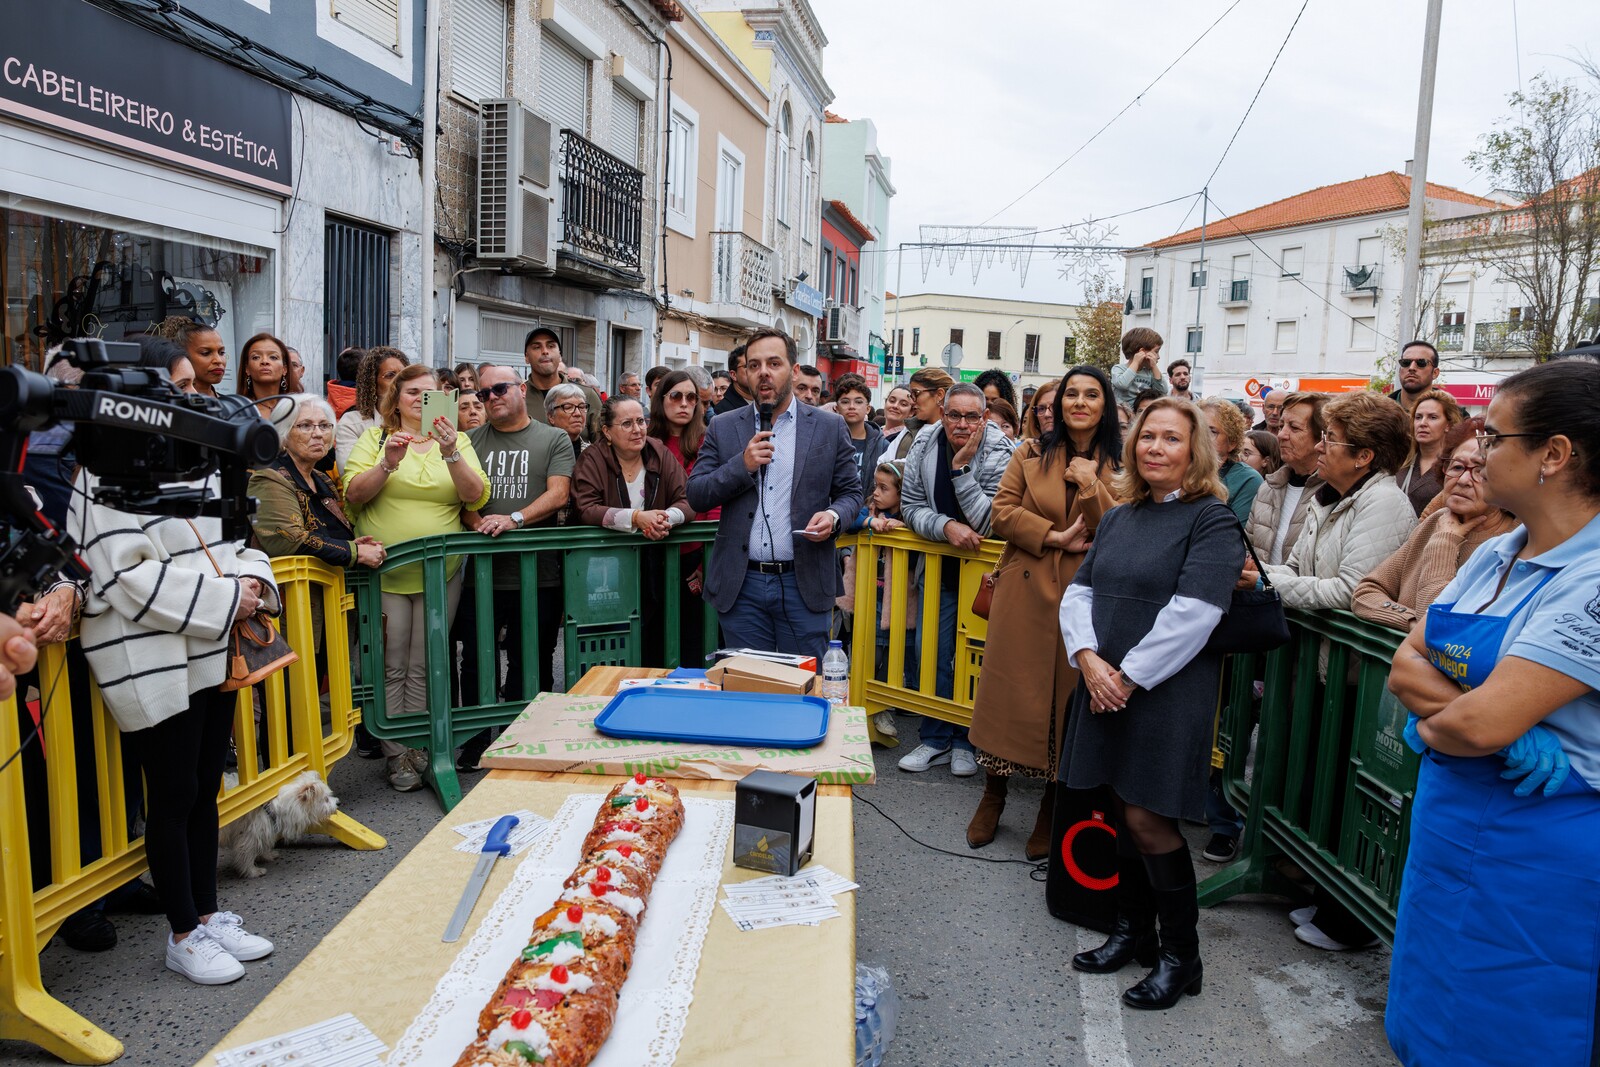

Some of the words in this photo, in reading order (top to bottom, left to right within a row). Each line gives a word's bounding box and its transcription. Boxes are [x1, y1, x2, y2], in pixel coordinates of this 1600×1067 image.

[4, 57, 174, 135] CABELEIREIRO
[182, 119, 197, 143] &
[200, 124, 279, 170] ESTÉTICA
[98, 397, 174, 429] RONIN
[485, 450, 529, 477] 1978
[490, 483, 528, 499] IFFOSI
[588, 591, 621, 601] MOITA
[1437, 650, 1468, 679] Mega
[1444, 643, 1472, 660] 2024
[1376, 731, 1403, 756] MOITA
